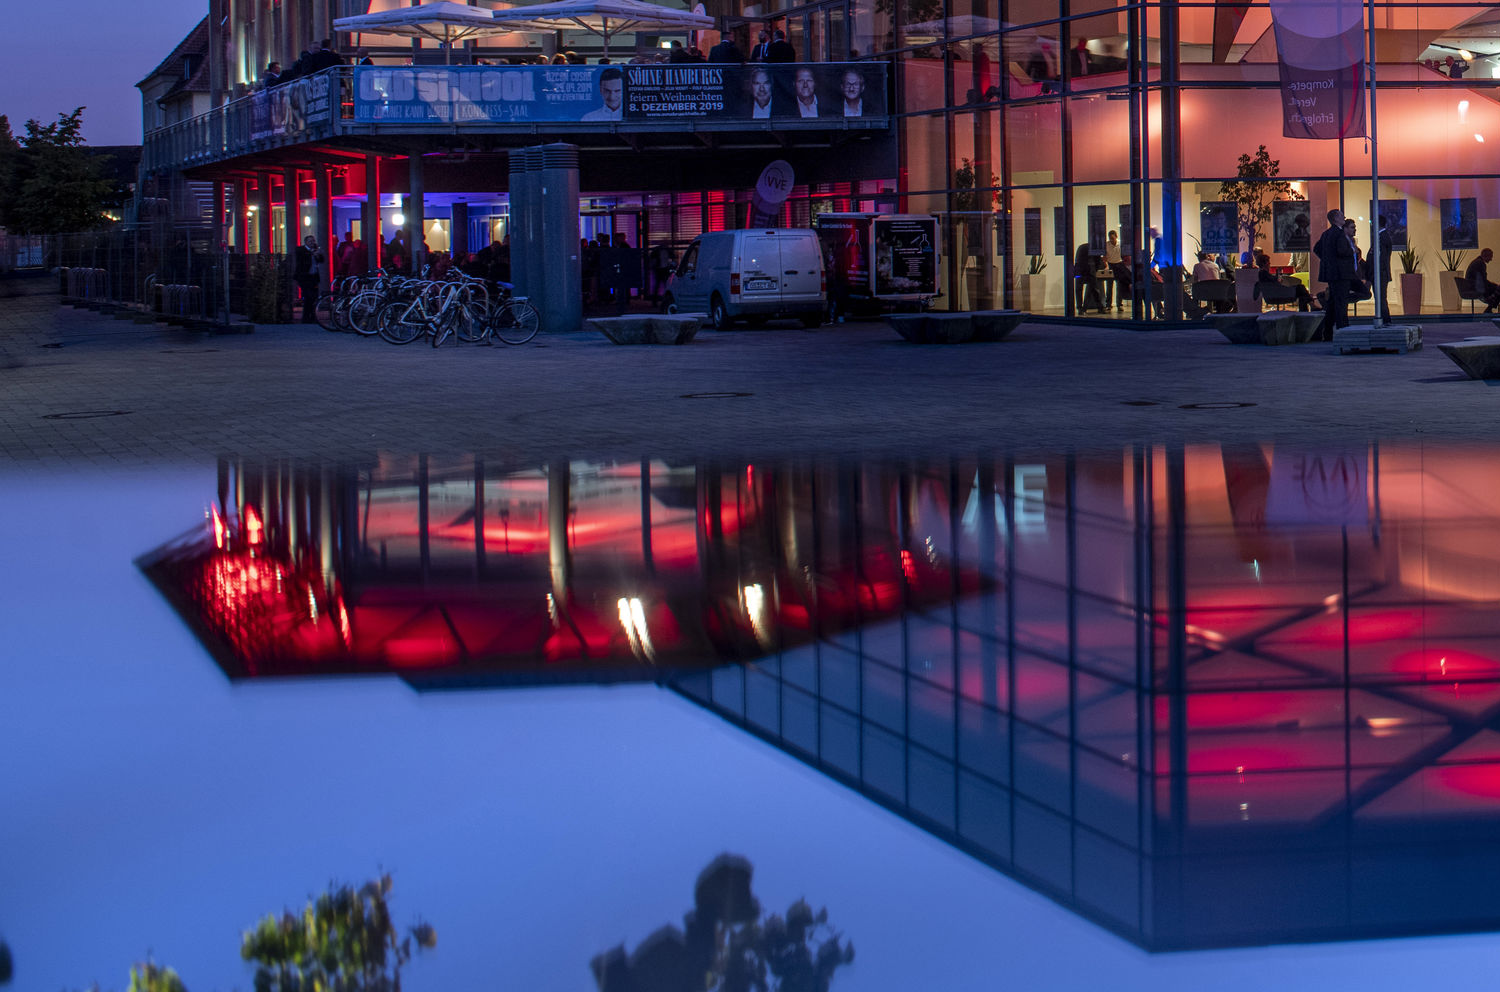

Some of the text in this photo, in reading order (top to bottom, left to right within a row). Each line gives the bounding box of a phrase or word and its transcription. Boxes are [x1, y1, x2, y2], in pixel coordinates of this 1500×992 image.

[628, 67, 723, 85] SÖHNE HAMBURGS
[630, 91, 723, 102] feiern Weihnachten
[629, 102, 723, 112] 8. DEZEMBER 2019
[767, 175, 787, 190] VVE
